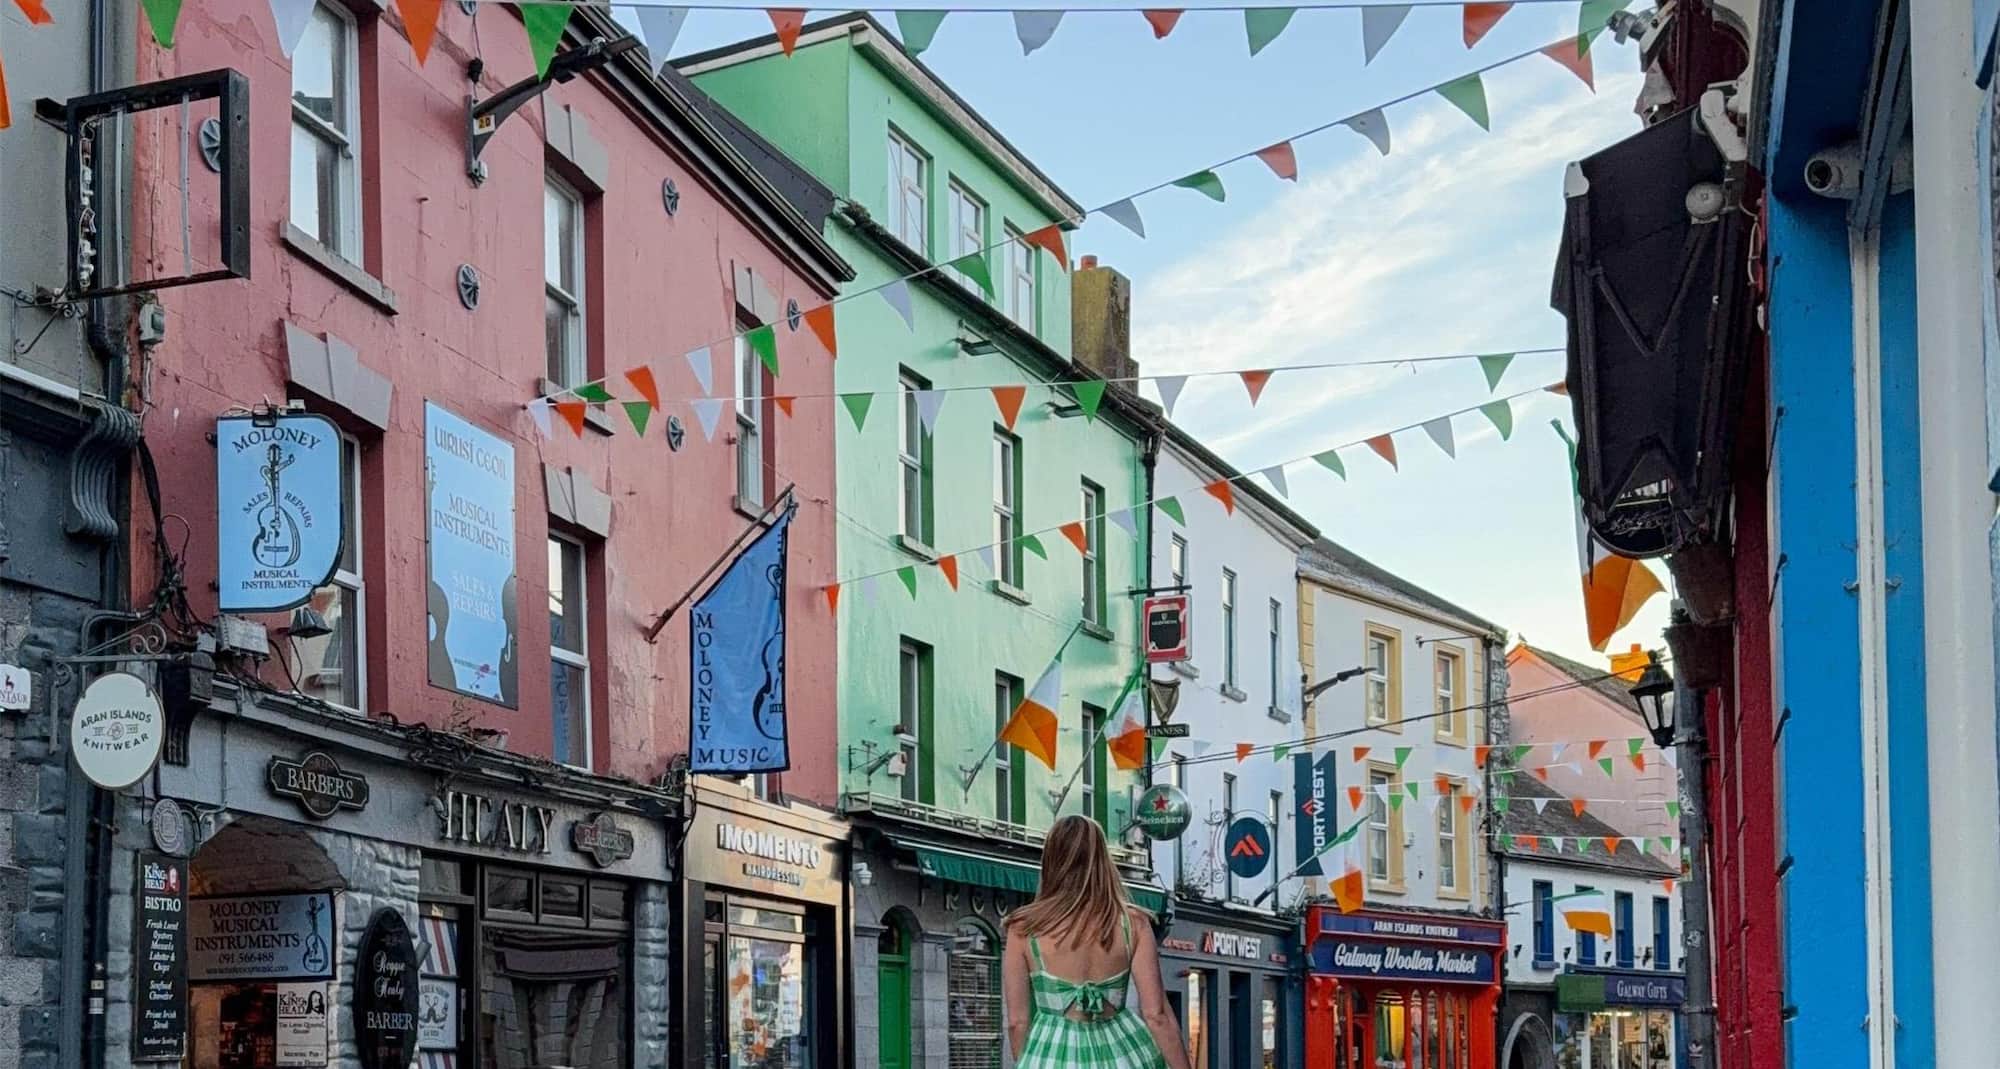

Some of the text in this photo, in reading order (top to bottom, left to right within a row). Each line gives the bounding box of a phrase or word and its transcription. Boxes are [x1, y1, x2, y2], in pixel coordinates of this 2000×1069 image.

[232, 427, 321, 453] MOLONEY
[242, 491, 312, 529] SALES REPAIRS
[449, 492, 498, 530] MUSICAL
[434, 509, 511, 558] INSTRUMENTS
[253, 569, 300, 579] MUSICAL
[241, 579, 314, 590] INSTRUMENTS
[696, 613, 714, 741] MOLONEY
[80, 709, 152, 728] ARAN ISLANDS
[83, 733, 149, 751] KNITWEAR
[698, 746, 769, 765] MUSIC
[287, 767, 354, 800] BARBERS
[144, 879, 166, 889] HEAD
[145, 896, 182, 912] BISTRO
[209, 901, 281, 919] MOLONEY
[213, 918, 279, 933] MUSICAL
[1373, 921, 1458, 937] ARAN ISLANDS KNITWEAR
[194, 933, 300, 951] INSTRUMENTS
[1213, 931, 1261, 960] PORTWEST
[218, 953, 234, 964] 091
[1334, 943, 1477, 974] Galway Woollen Market
[279, 1006, 304, 1015] HEAD
[367, 1011, 414, 1031] BARBER
